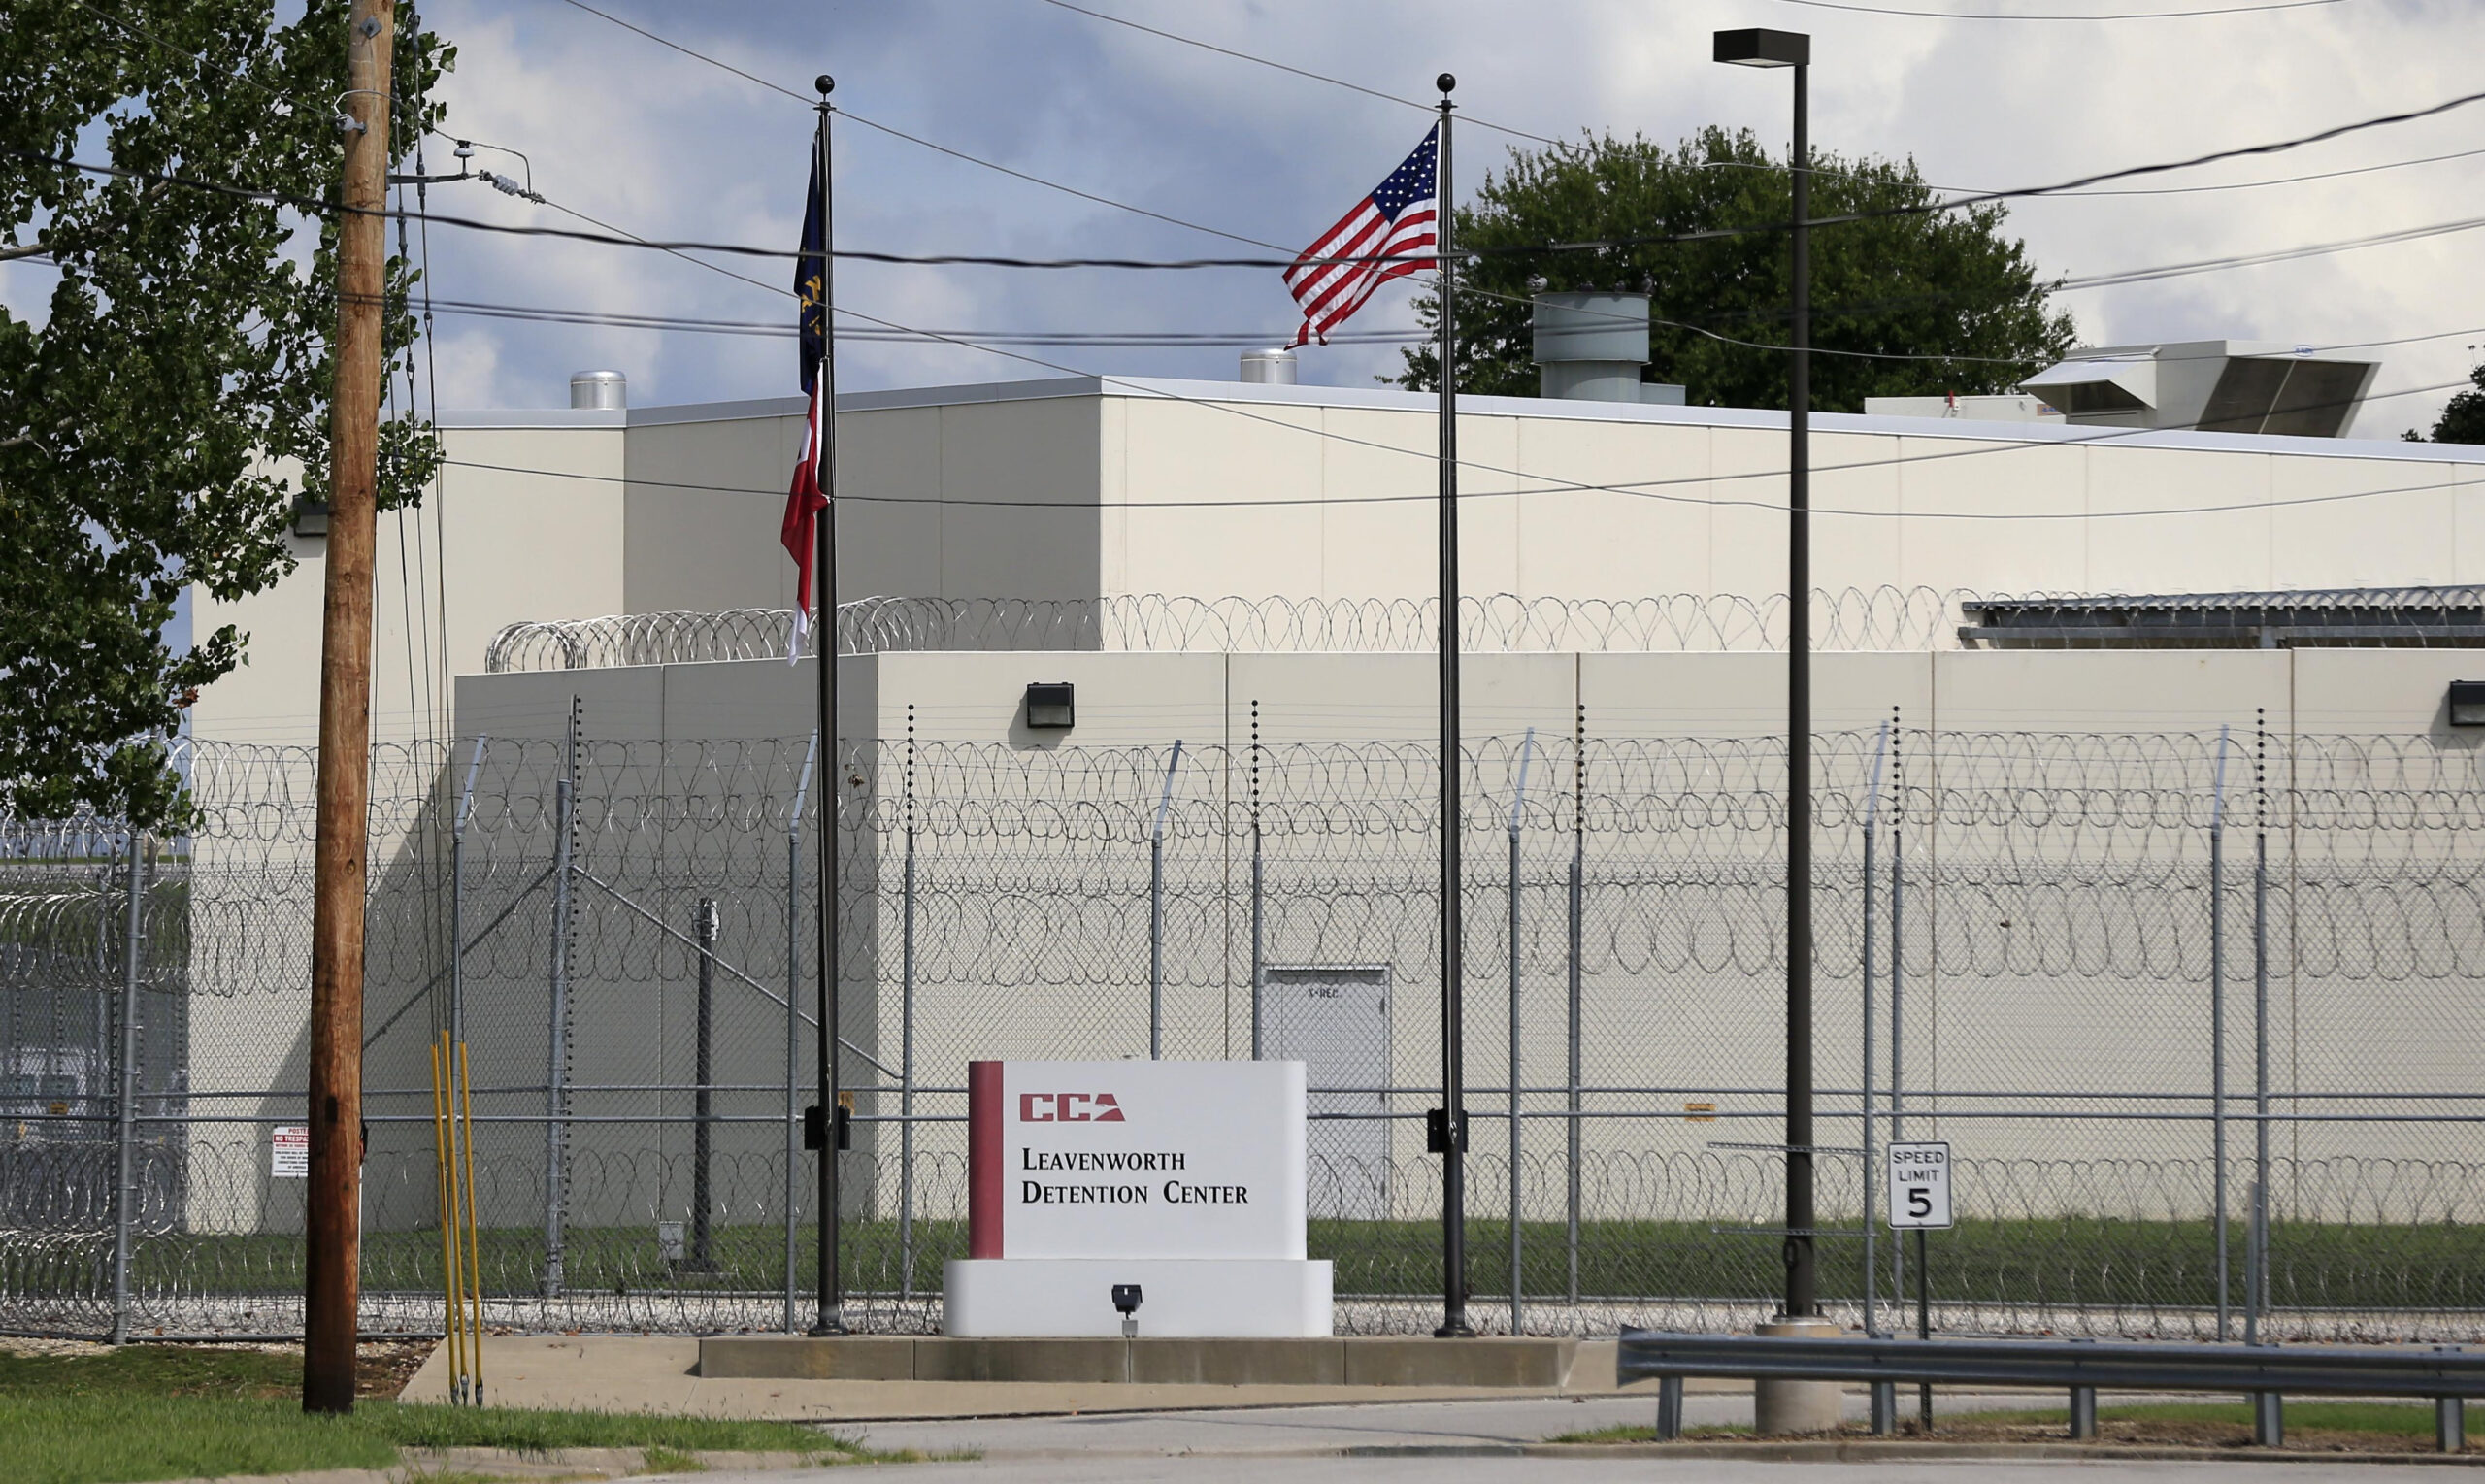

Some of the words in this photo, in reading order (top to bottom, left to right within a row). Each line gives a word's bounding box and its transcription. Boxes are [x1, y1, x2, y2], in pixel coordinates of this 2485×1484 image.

[1019, 1093, 1126, 1122] CCA
[1021, 1147, 1186, 1171] LEAVENWORTH
[1893, 1151, 1945, 1164] SPEED
[1898, 1170, 1940, 1182] LIMIT
[1021, 1180, 1148, 1204] DETENTION
[1163, 1180, 1249, 1204] CENTER
[1908, 1188, 1933, 1218] 5
